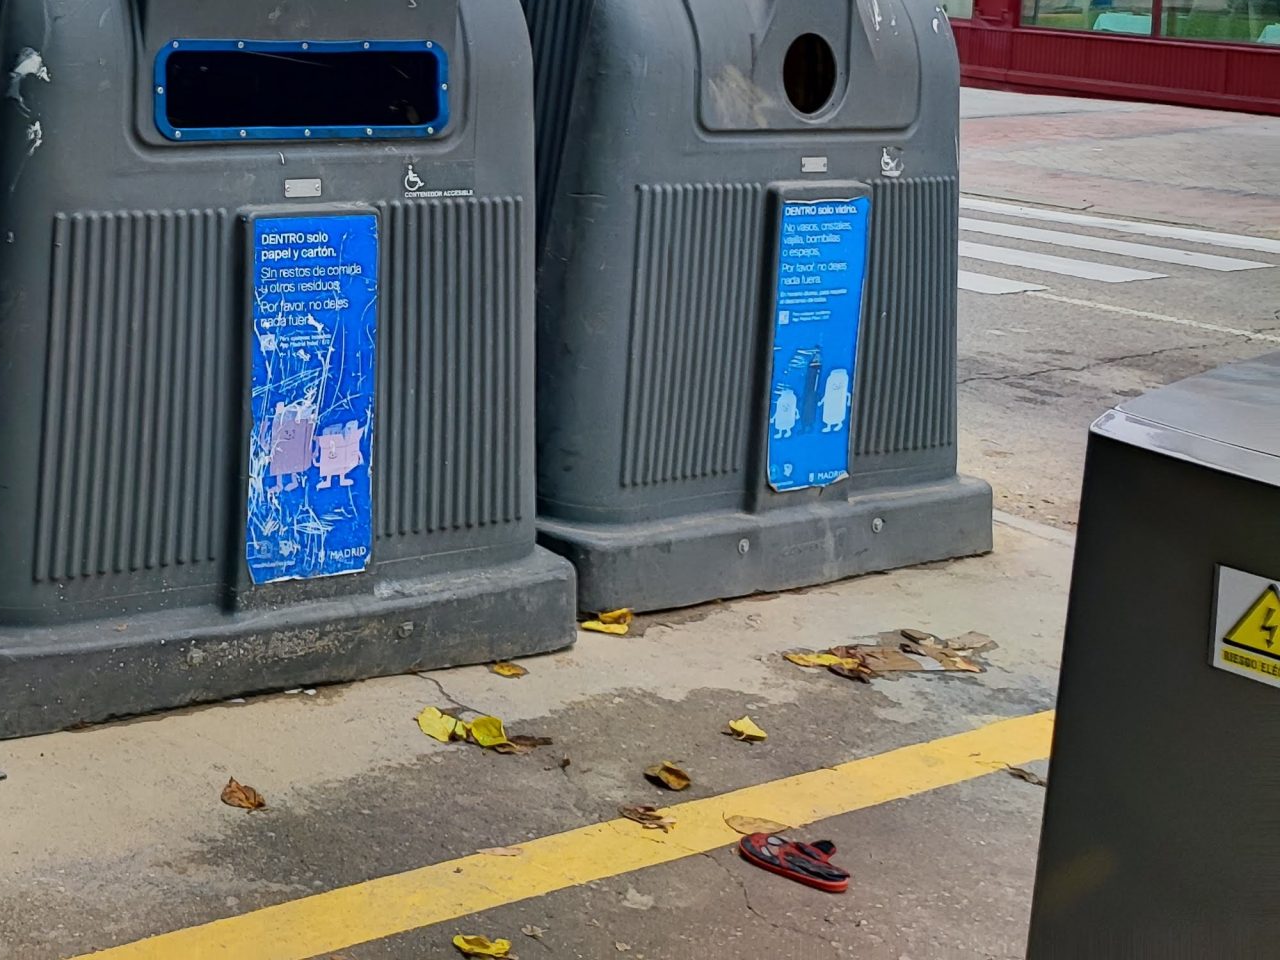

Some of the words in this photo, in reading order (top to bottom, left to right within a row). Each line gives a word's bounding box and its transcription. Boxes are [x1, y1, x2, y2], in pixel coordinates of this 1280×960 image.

[404, 190, 442, 198] CONTENEDOR
[444, 189, 473, 197] ACCESIBLE
[785, 206, 817, 216] DENTRO
[818, 205, 834, 215] solo
[784, 223, 795, 231] No
[261, 233, 305, 245] DENTRO
[306, 231, 328, 243] solo
[261, 247, 291, 262] papel
[293, 249, 299, 261] y
[301, 245, 336, 258] cartón.
[261, 266, 277, 279] Sin
[279, 266, 310, 278] restos
[312, 264, 326, 276] de
[327, 263, 362, 275] comida
[781, 263, 794, 272] Por
[817, 263, 827, 271] no
[269, 282, 295, 293] otros
[261, 301, 278, 313] Por
[309, 300, 322, 310] no
[323, 298, 349, 311] dejes
[261, 315, 287, 328] nada
[288, 314, 314, 326] fuer
[330, 546, 367, 560] MADRID
[1223, 651, 1257, 670] RIESGO
[1261, 662, 1280, 678] ELÉ
